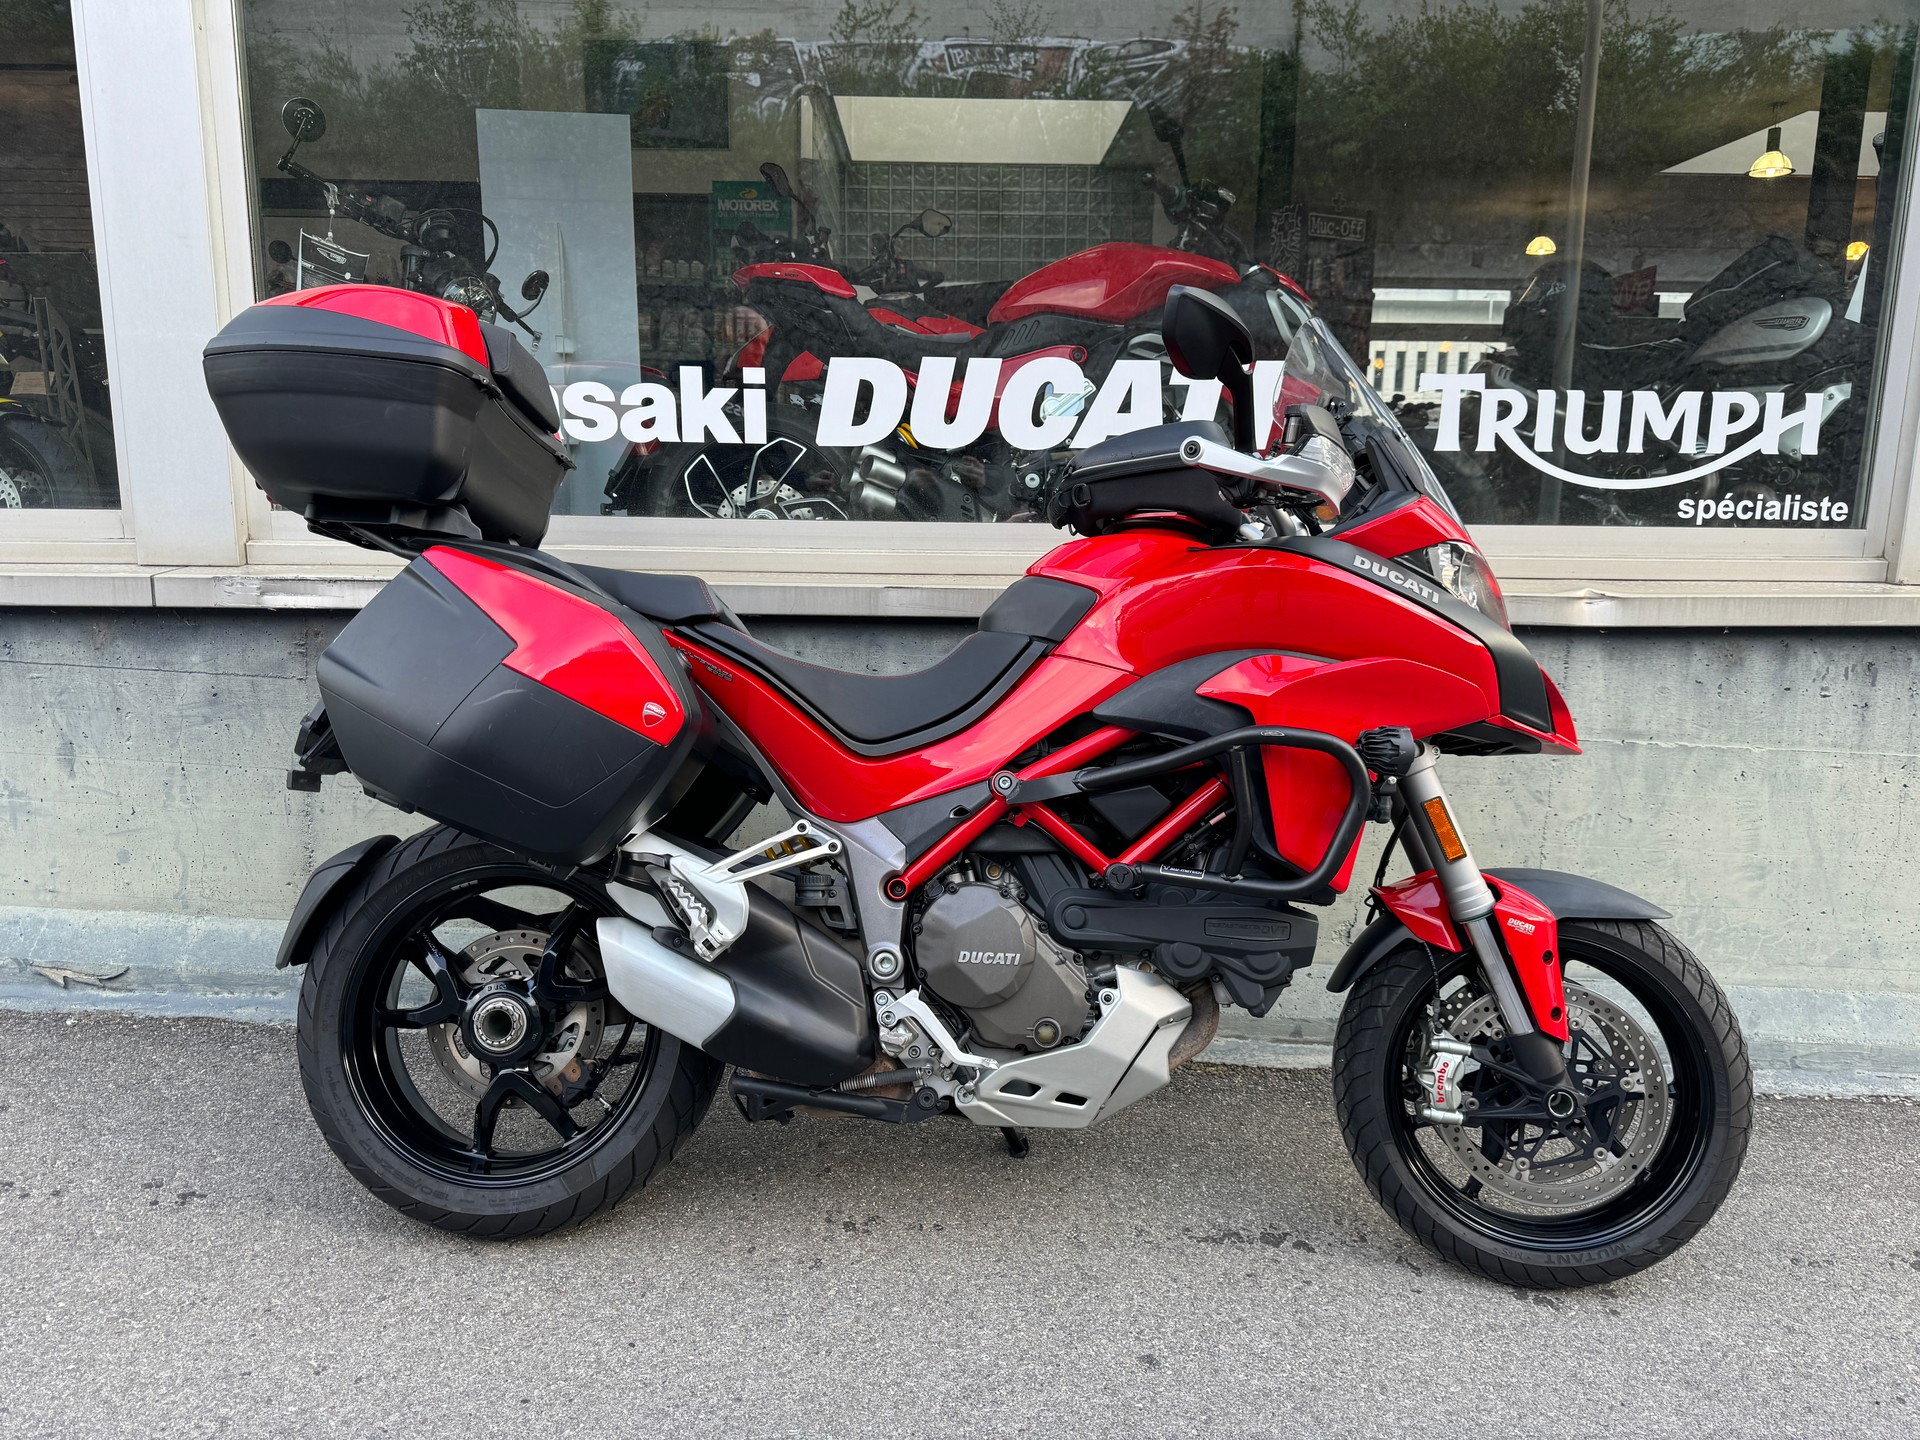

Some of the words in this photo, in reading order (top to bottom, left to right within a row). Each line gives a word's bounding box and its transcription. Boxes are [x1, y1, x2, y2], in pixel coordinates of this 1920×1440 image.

[717, 198, 779, 211] MOTOREX
[1310, 216, 1364, 238] Muc-Off
[549, 365, 768, 445] saki
[815, 356, 1285, 451] DUCATI
[1419, 373, 1825, 489] TRIUMPH
[1677, 494, 1849, 526] spécialiste
[1353, 555, 1440, 604] DUCATI
[1507, 917, 1536, 933] DUCATI
[957, 950, 1021, 966] DUCATI
[1436, 1062, 1449, 1104] brembo
[1543, 1241, 1626, 1265] MUTANT
